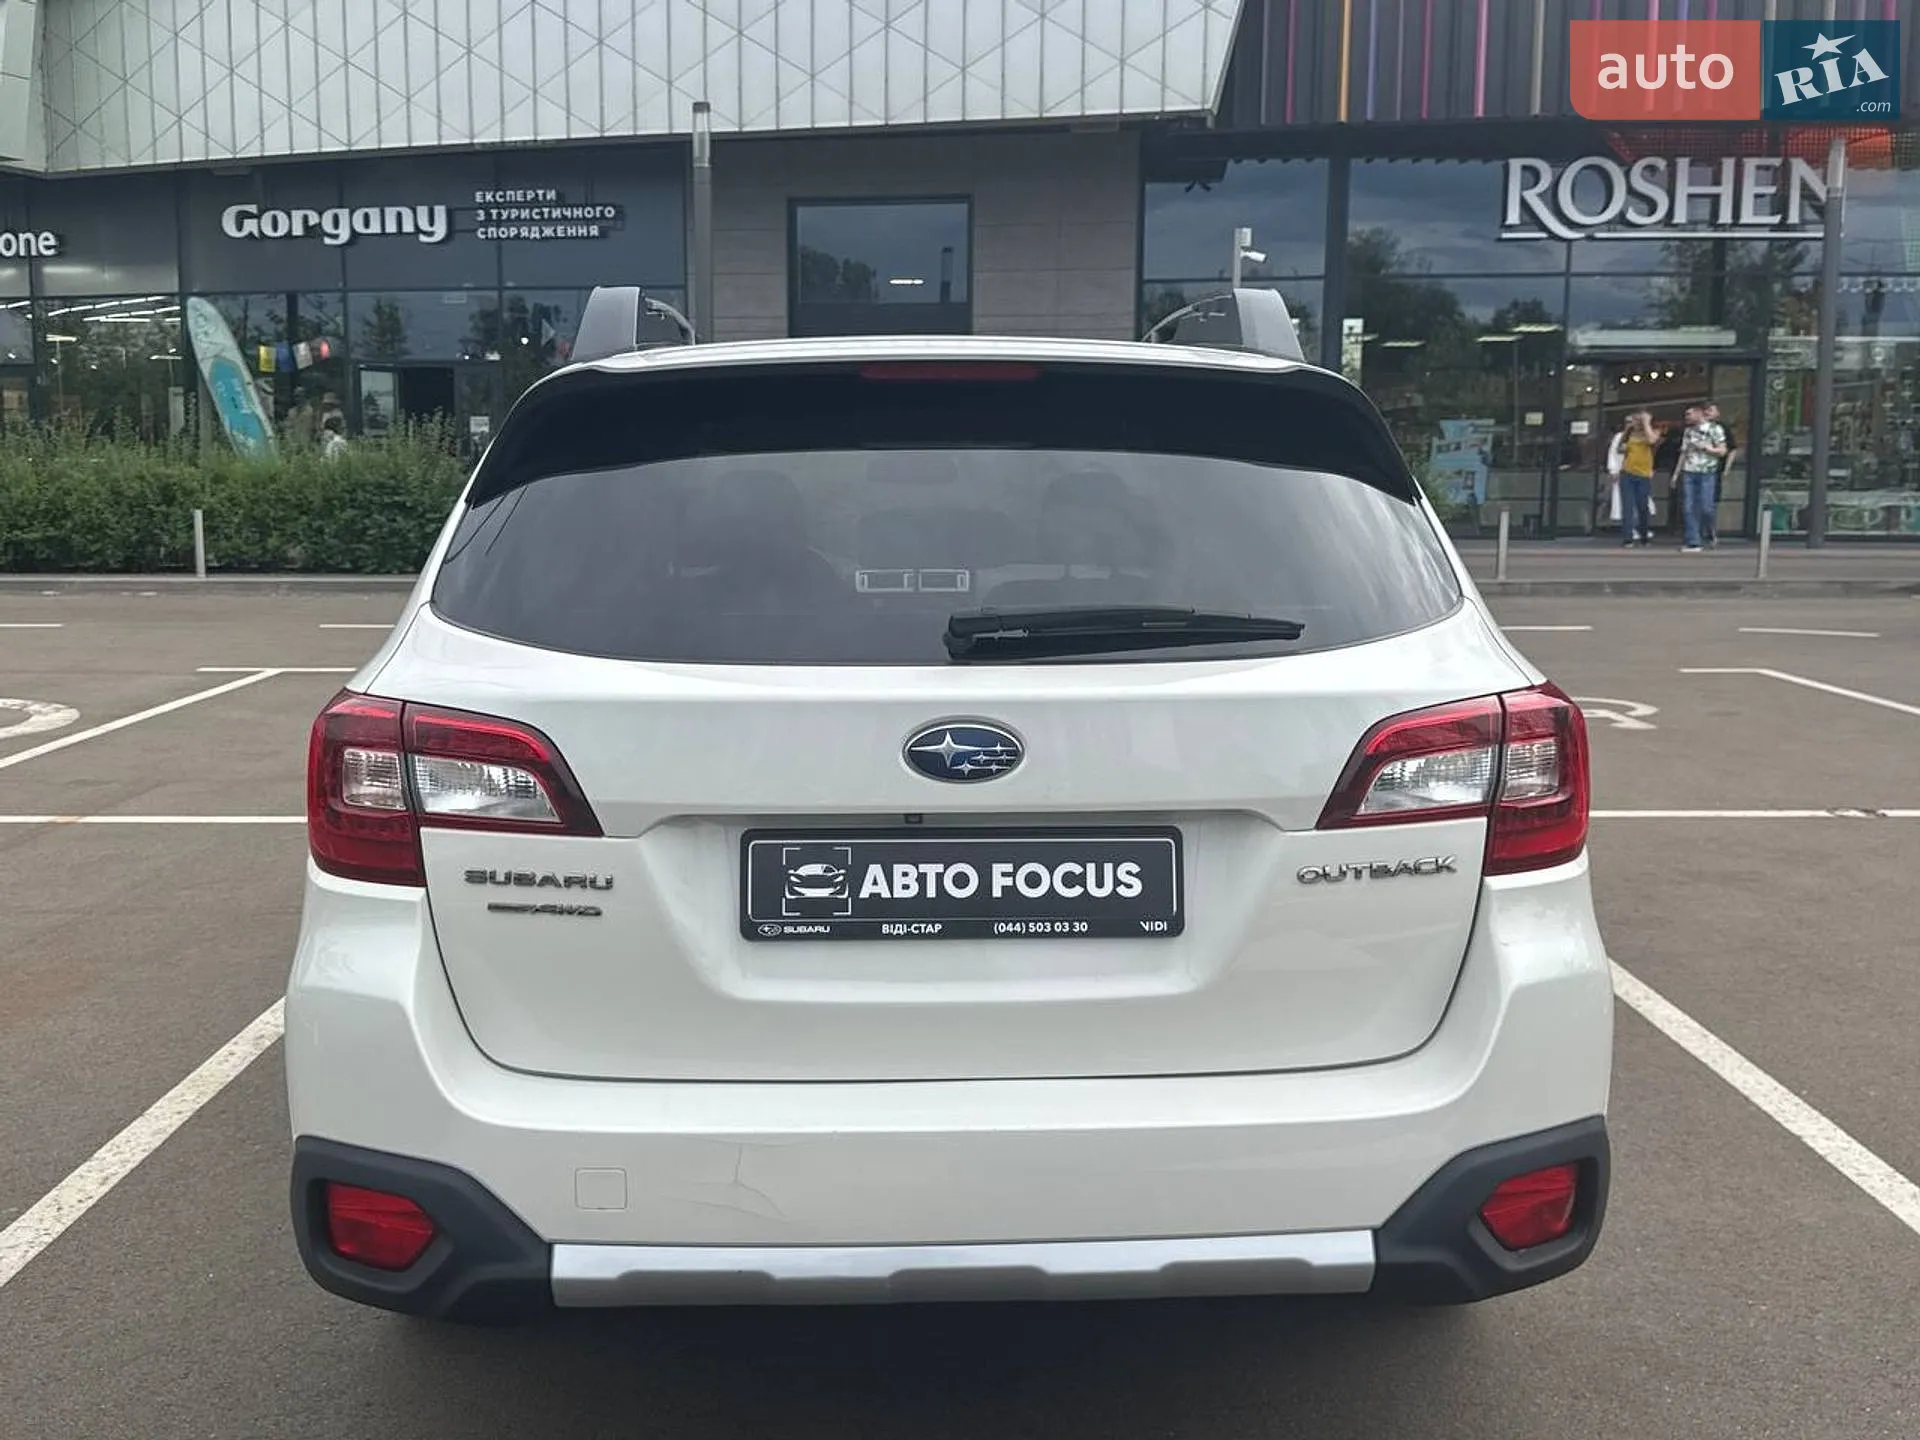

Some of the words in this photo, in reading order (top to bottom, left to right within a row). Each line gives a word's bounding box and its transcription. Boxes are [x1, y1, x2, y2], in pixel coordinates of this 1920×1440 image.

[475, 189, 557, 203] ЕКСПЕРТИ
[1504, 156, 1828, 240] ROSHEN
[491, 206, 616, 221] ТУРИСТИЧНОГО
[222, 203, 447, 245] Gorgany
[477, 225, 600, 239] СПОРЯДЖЕННЯ
[1297, 854, 1457, 884] OUTBACK
[464, 869, 614, 890] SUBARU
[858, 862, 979, 897] АВТО
[992, 862, 1143, 897] FOCUS
[783, 926, 831, 934] SUBARU
[882, 924, 942, 935] ВІДІ-СТАР
[993, 921, 1026, 934] (044)
[1029, 922, 1050, 932] 503
[1054, 922, 1069, 932] 03
[1072, 922, 1088, 932] 30
[1140, 921, 1167, 931] VIDI
